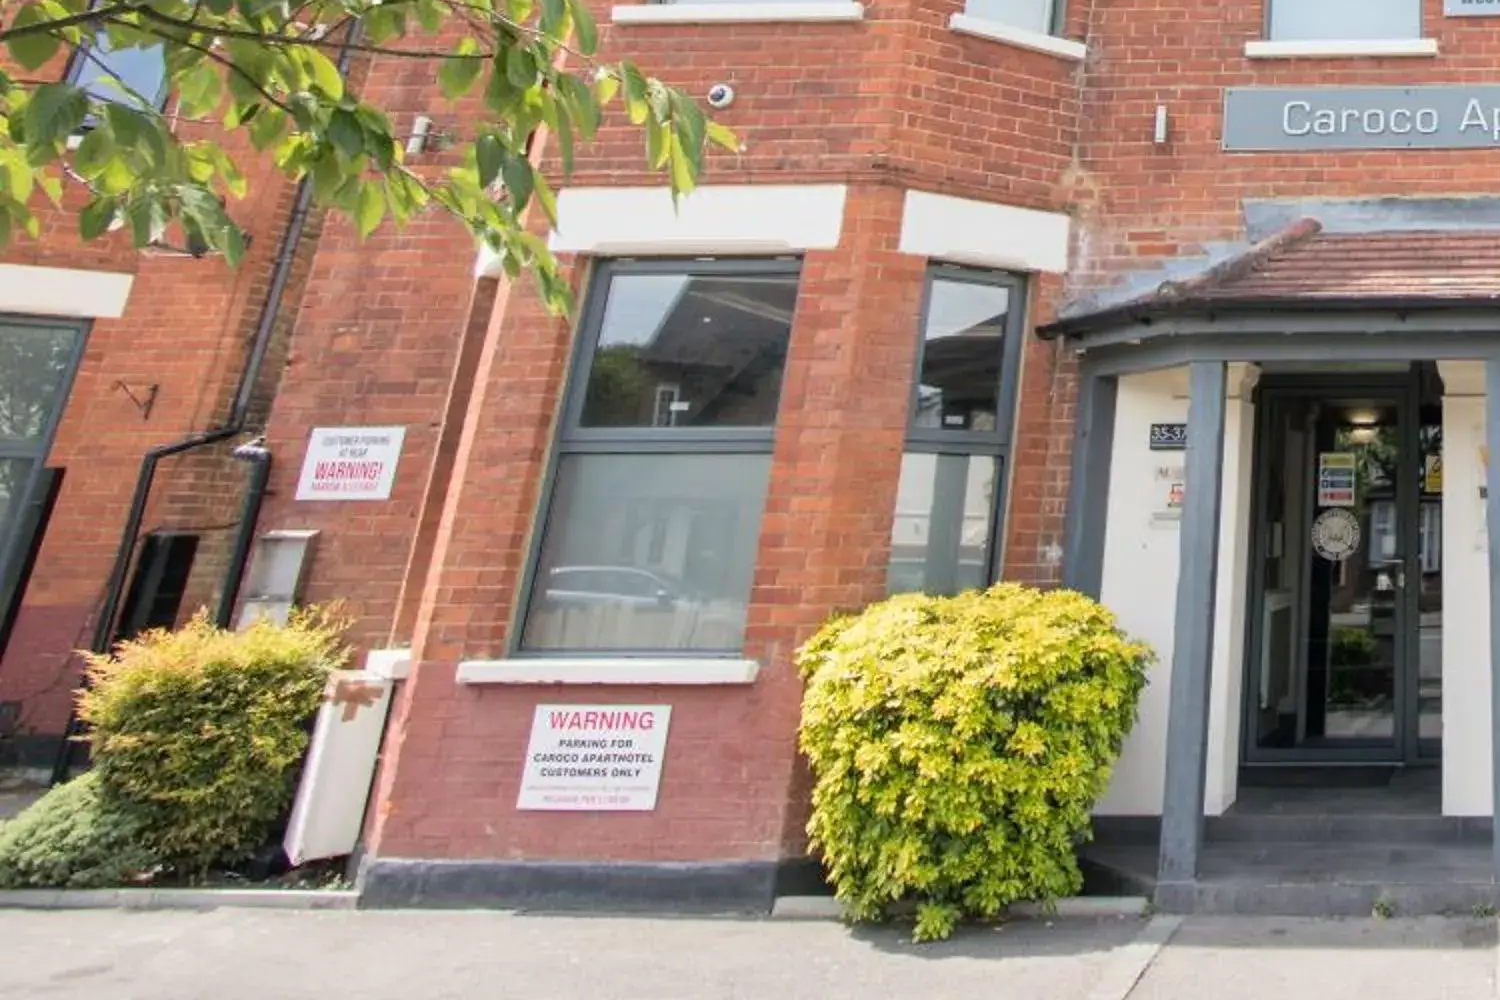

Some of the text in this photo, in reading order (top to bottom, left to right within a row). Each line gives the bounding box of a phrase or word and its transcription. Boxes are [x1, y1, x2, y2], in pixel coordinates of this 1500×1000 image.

[1282, 100, 1439, 135] Caroco
[314, 461, 384, 481] WARNING!
[550, 711, 655, 730] WARNING
[558, 739, 633, 749] PARKING FOR
[533, 753, 654, 763] CAROCO APARTHOTEL
[540, 768, 641, 777] CUSTOMERS ONLY
